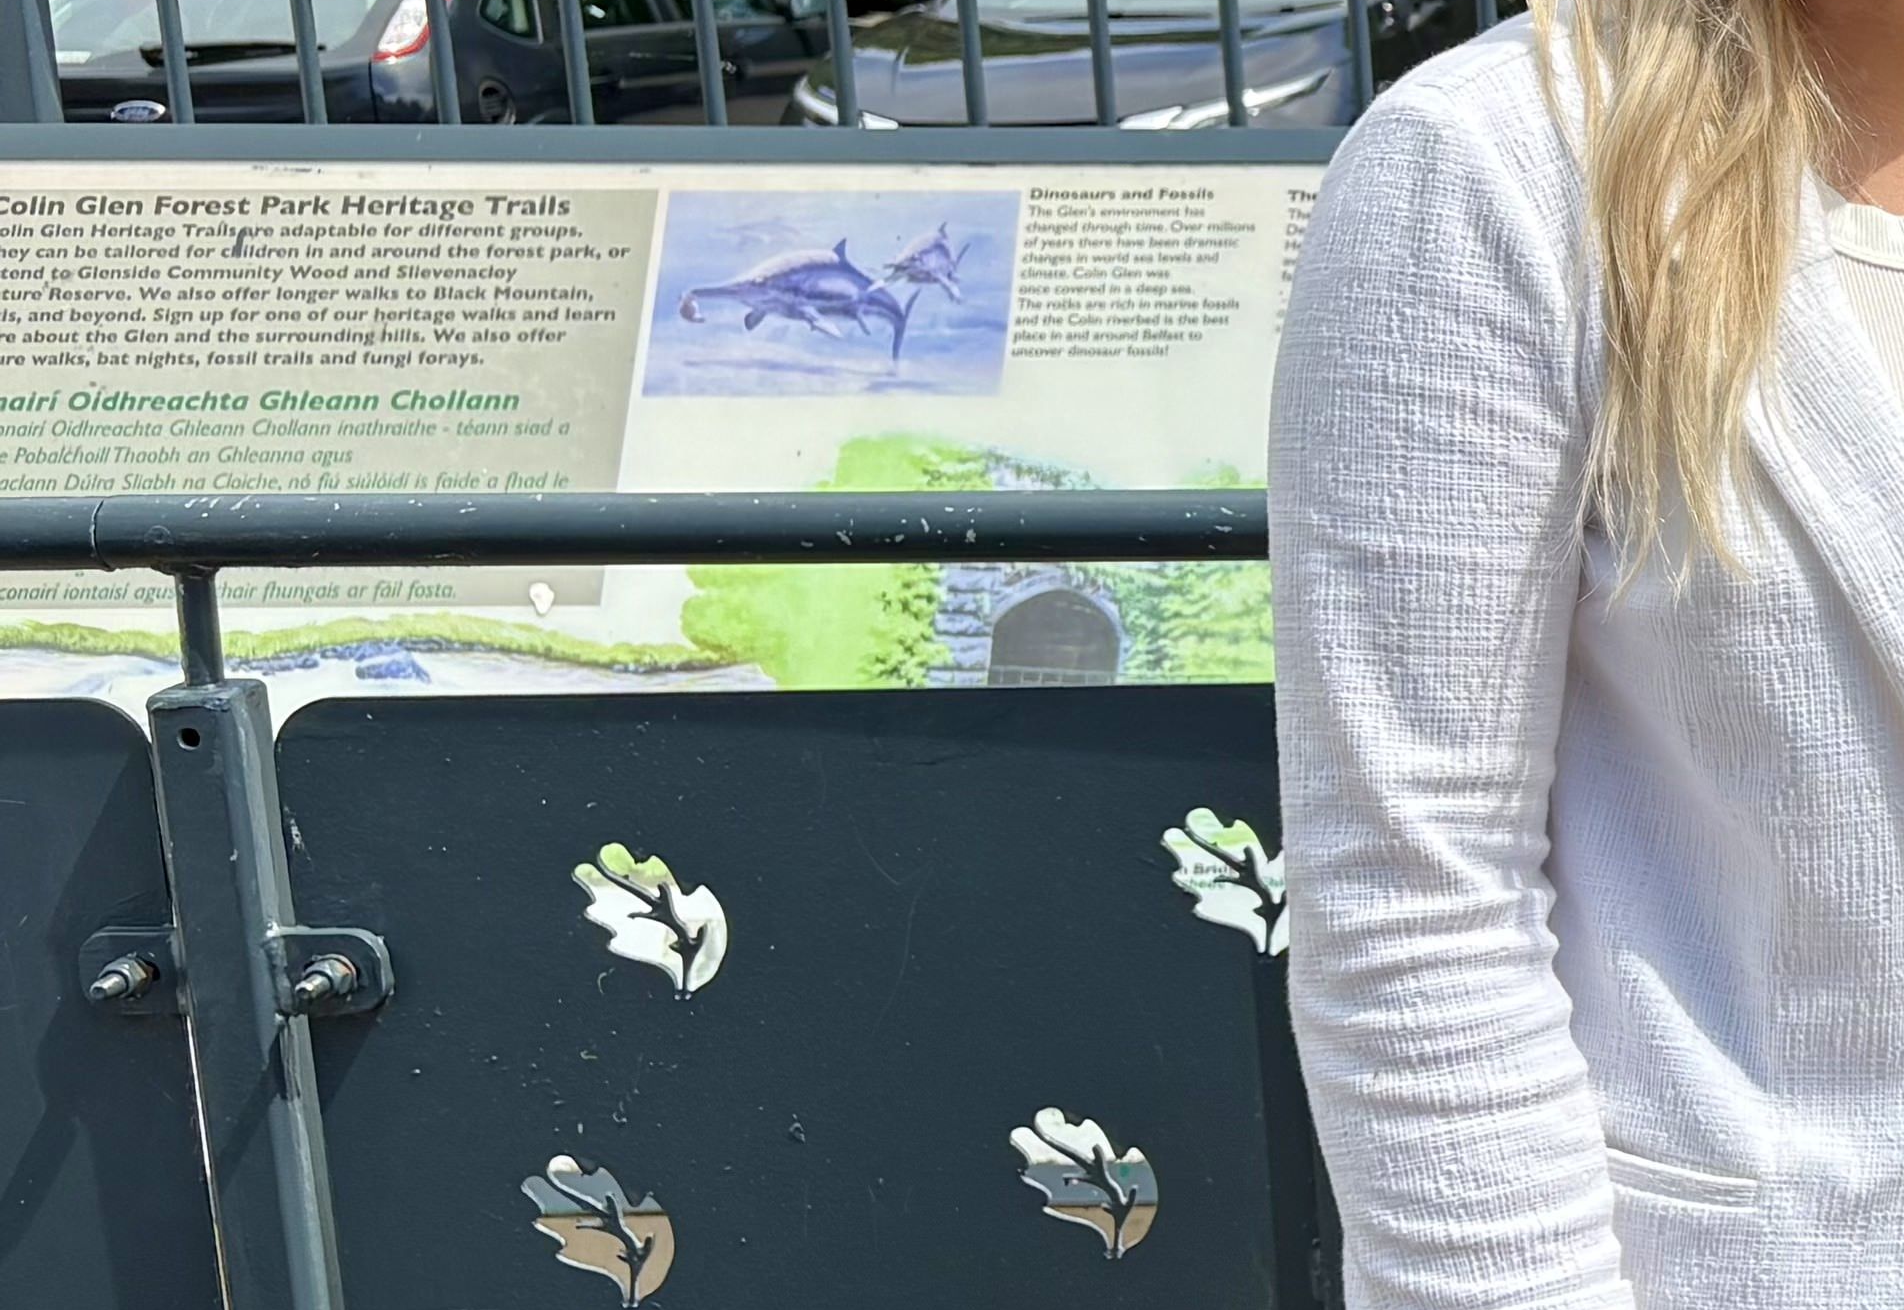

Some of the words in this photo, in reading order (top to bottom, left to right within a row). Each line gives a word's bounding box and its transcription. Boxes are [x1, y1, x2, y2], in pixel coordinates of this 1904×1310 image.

[1029, 187, 1116, 200] Dinosaurs
[1121, 188, 1154, 200] and
[1158, 188, 1214, 200] Fossils
[75, 195, 143, 216] Glen
[154, 195, 251, 216] Forest
[260, 195, 330, 216] Park
[341, 195, 474, 221] Heritage
[485, 195, 570, 216] Trails
[0, 224, 34, 238] olin
[40, 223, 84, 238] Glen
[90, 223, 176, 241] Heritage
[182, 220, 236, 237] Trails
[240, 226, 274, 238] are
[280, 223, 378, 241] adaptable
[383, 223, 413, 237] for
[418, 223, 504, 237] different
[510, 226, 583, 241] groups.
[35, 248, 69, 259] can
[74, 245, 98, 259] be
[104, 244, 181, 259] tailored
[186, 244, 216, 259] for
[305, 244, 324, 259] in
[329, 244, 366, 258] and
[371, 244, 442, 258] around
[447, 244, 480, 259] the
[486, 244, 544, 259] forest
[549, 244, 601, 262] park,
[608, 247, 630, 258] or
[0, 266, 45, 280] tend
[51, 267, 73, 281] to
[77, 265, 161, 280] Glenside
[167, 265, 284, 283] Community
[289, 265, 349, 280] Wood
[353, 265, 391, 279] and
[396, 265, 517, 283] Slievenacloy
[1, 286, 45, 301] ture
[48, 287, 132, 301] Reserve.
[138, 286, 172, 301] We
[177, 286, 216, 301] also
[221, 286, 271, 301] offer
[276, 286, 340, 304] longer
[345, 286, 399, 300] walks
[406, 287, 427, 300] to
[433, 286, 486, 300] Black
[493, 286, 593, 302] Mountain,
[27, 309, 65, 322] and
[69, 307, 146, 327] beyond.
[152, 307, 194, 326] Sign
[199, 310, 224, 326] up
[230, 307, 260, 322] for
[265, 310, 302, 322] one
[307, 307, 329, 322] of
[333, 310, 369, 321] our
[373, 307, 456, 327] heritage
[461, 307, 516, 321] walks
[522, 307, 559, 321] and
[565, 307, 616, 321] learn
[22, 329, 79, 343] about
[85, 329, 118, 343] the
[124, 328, 169, 343] Glen
[174, 328, 211, 343] and
[217, 328, 250, 343] the
[255, 328, 375, 346] surrounding
[380, 329, 425, 343] hills.
[433, 328, 466, 343] We
[472, 328, 511, 343] also
[517, 328, 566, 342] offer
[31, 351, 91, 368] walks,
[96, 351, 129, 365] bat
[135, 351, 200, 369] nights,
[207, 351, 258, 365] fossil
[263, 350, 313, 365] trails
[319, 350, 357, 365] and
[362, 350, 412, 369] fungi
[418, 350, 484, 369] forays.
[68, 390, 249, 412] Oidhreachta
[259, 390, 379, 411] Ghleann
[390, 389, 520, 411] Chollann
[114, 446, 181, 464] Thaobh
[187, 450, 210, 464] an
[217, 445, 305, 464] Ghleanna
[311, 450, 353, 467] agus
